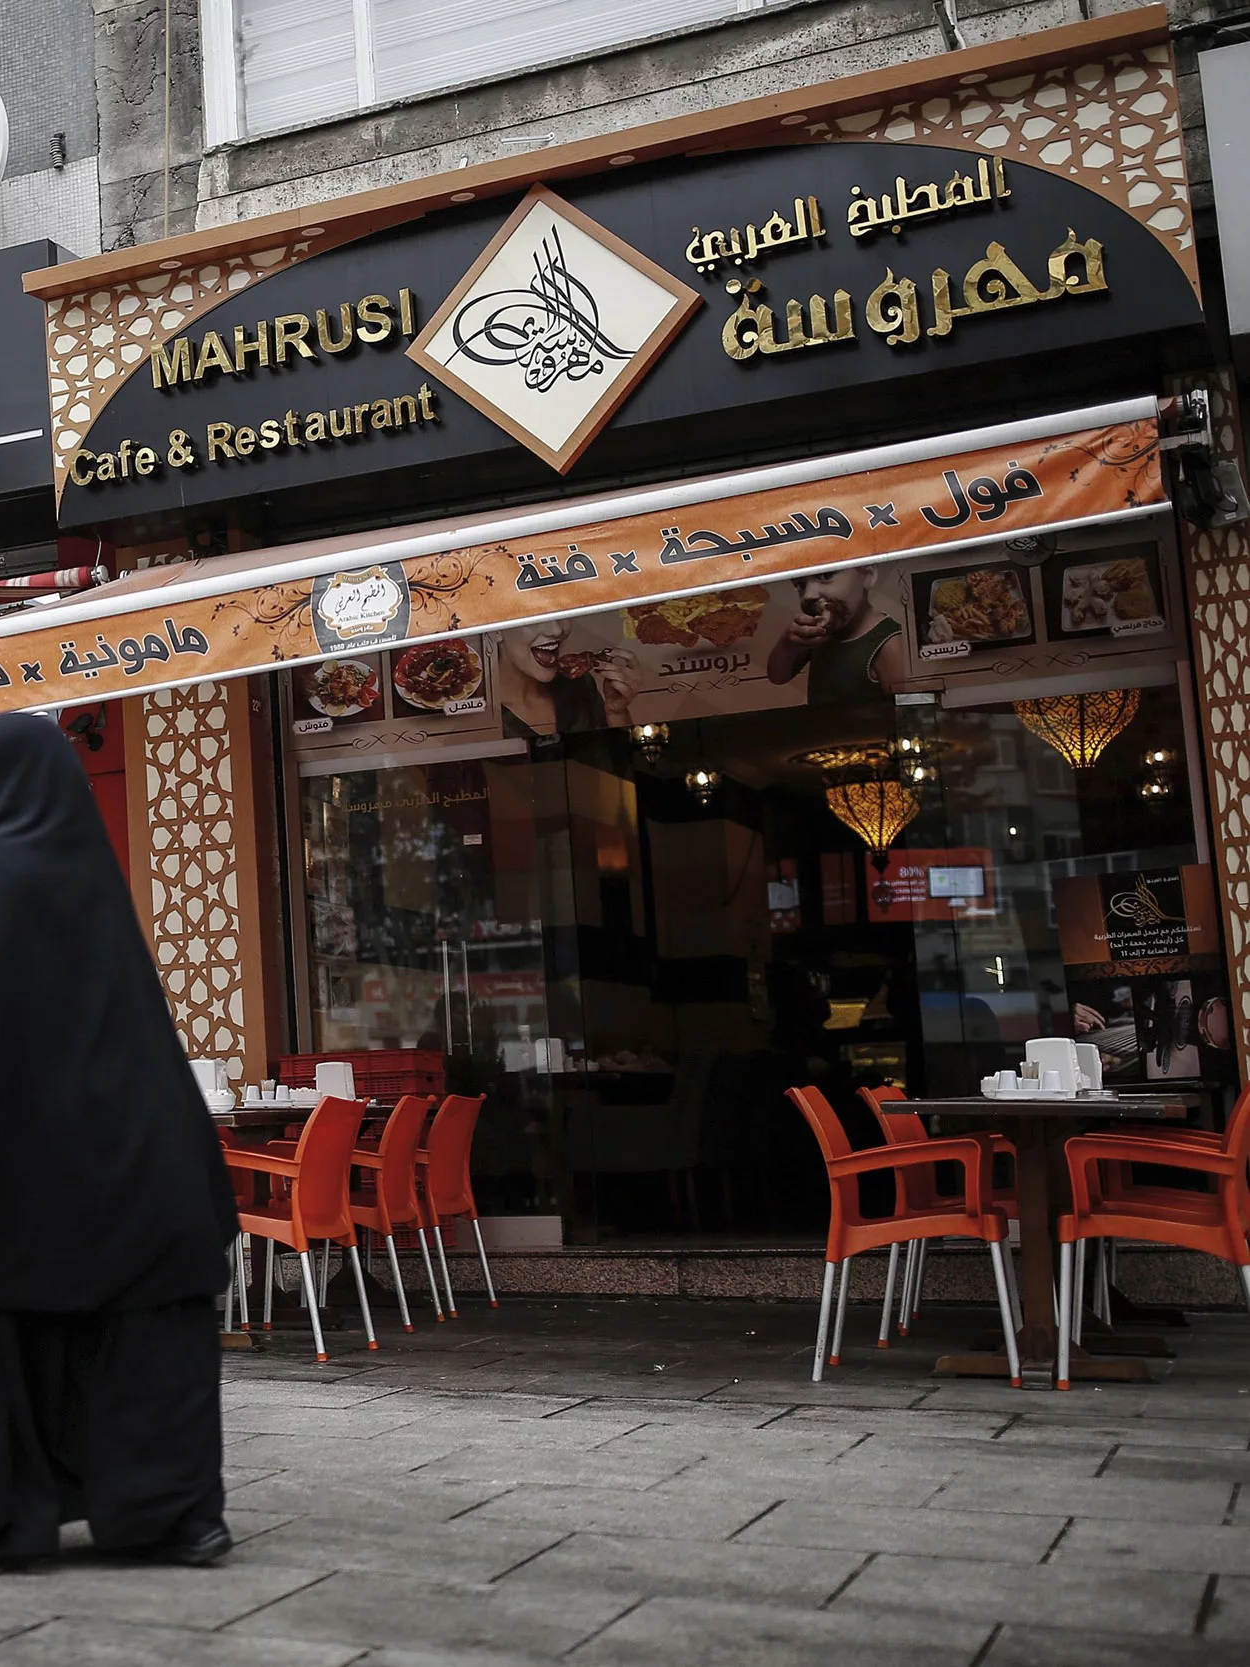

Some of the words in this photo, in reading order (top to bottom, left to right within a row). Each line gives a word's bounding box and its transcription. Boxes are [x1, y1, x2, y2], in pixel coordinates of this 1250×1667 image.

[846, 155, 1012, 238] المطبخ
[684, 195, 827, 275] العربي
[720, 225, 1110, 361] مهروسة
[150, 287, 416, 390] MAHRUSI
[69, 438, 160, 487] Cafe
[167, 427, 198, 468] &
[206, 382, 438, 462] Restaurant
[920, 459, 1044, 530] فول
[657, 505, 854, 566] مسبحة
[514, 543, 598, 592] فتة
[360, 610, 385, 620] Kitchen
[57, 617, 211, 681] مامونية
[658, 653, 751, 677] بروستد
[920, 642, 969, 659] كريسبي
[299, 720, 329, 732] فتوش
[449, 701, 484, 713] فلافل
